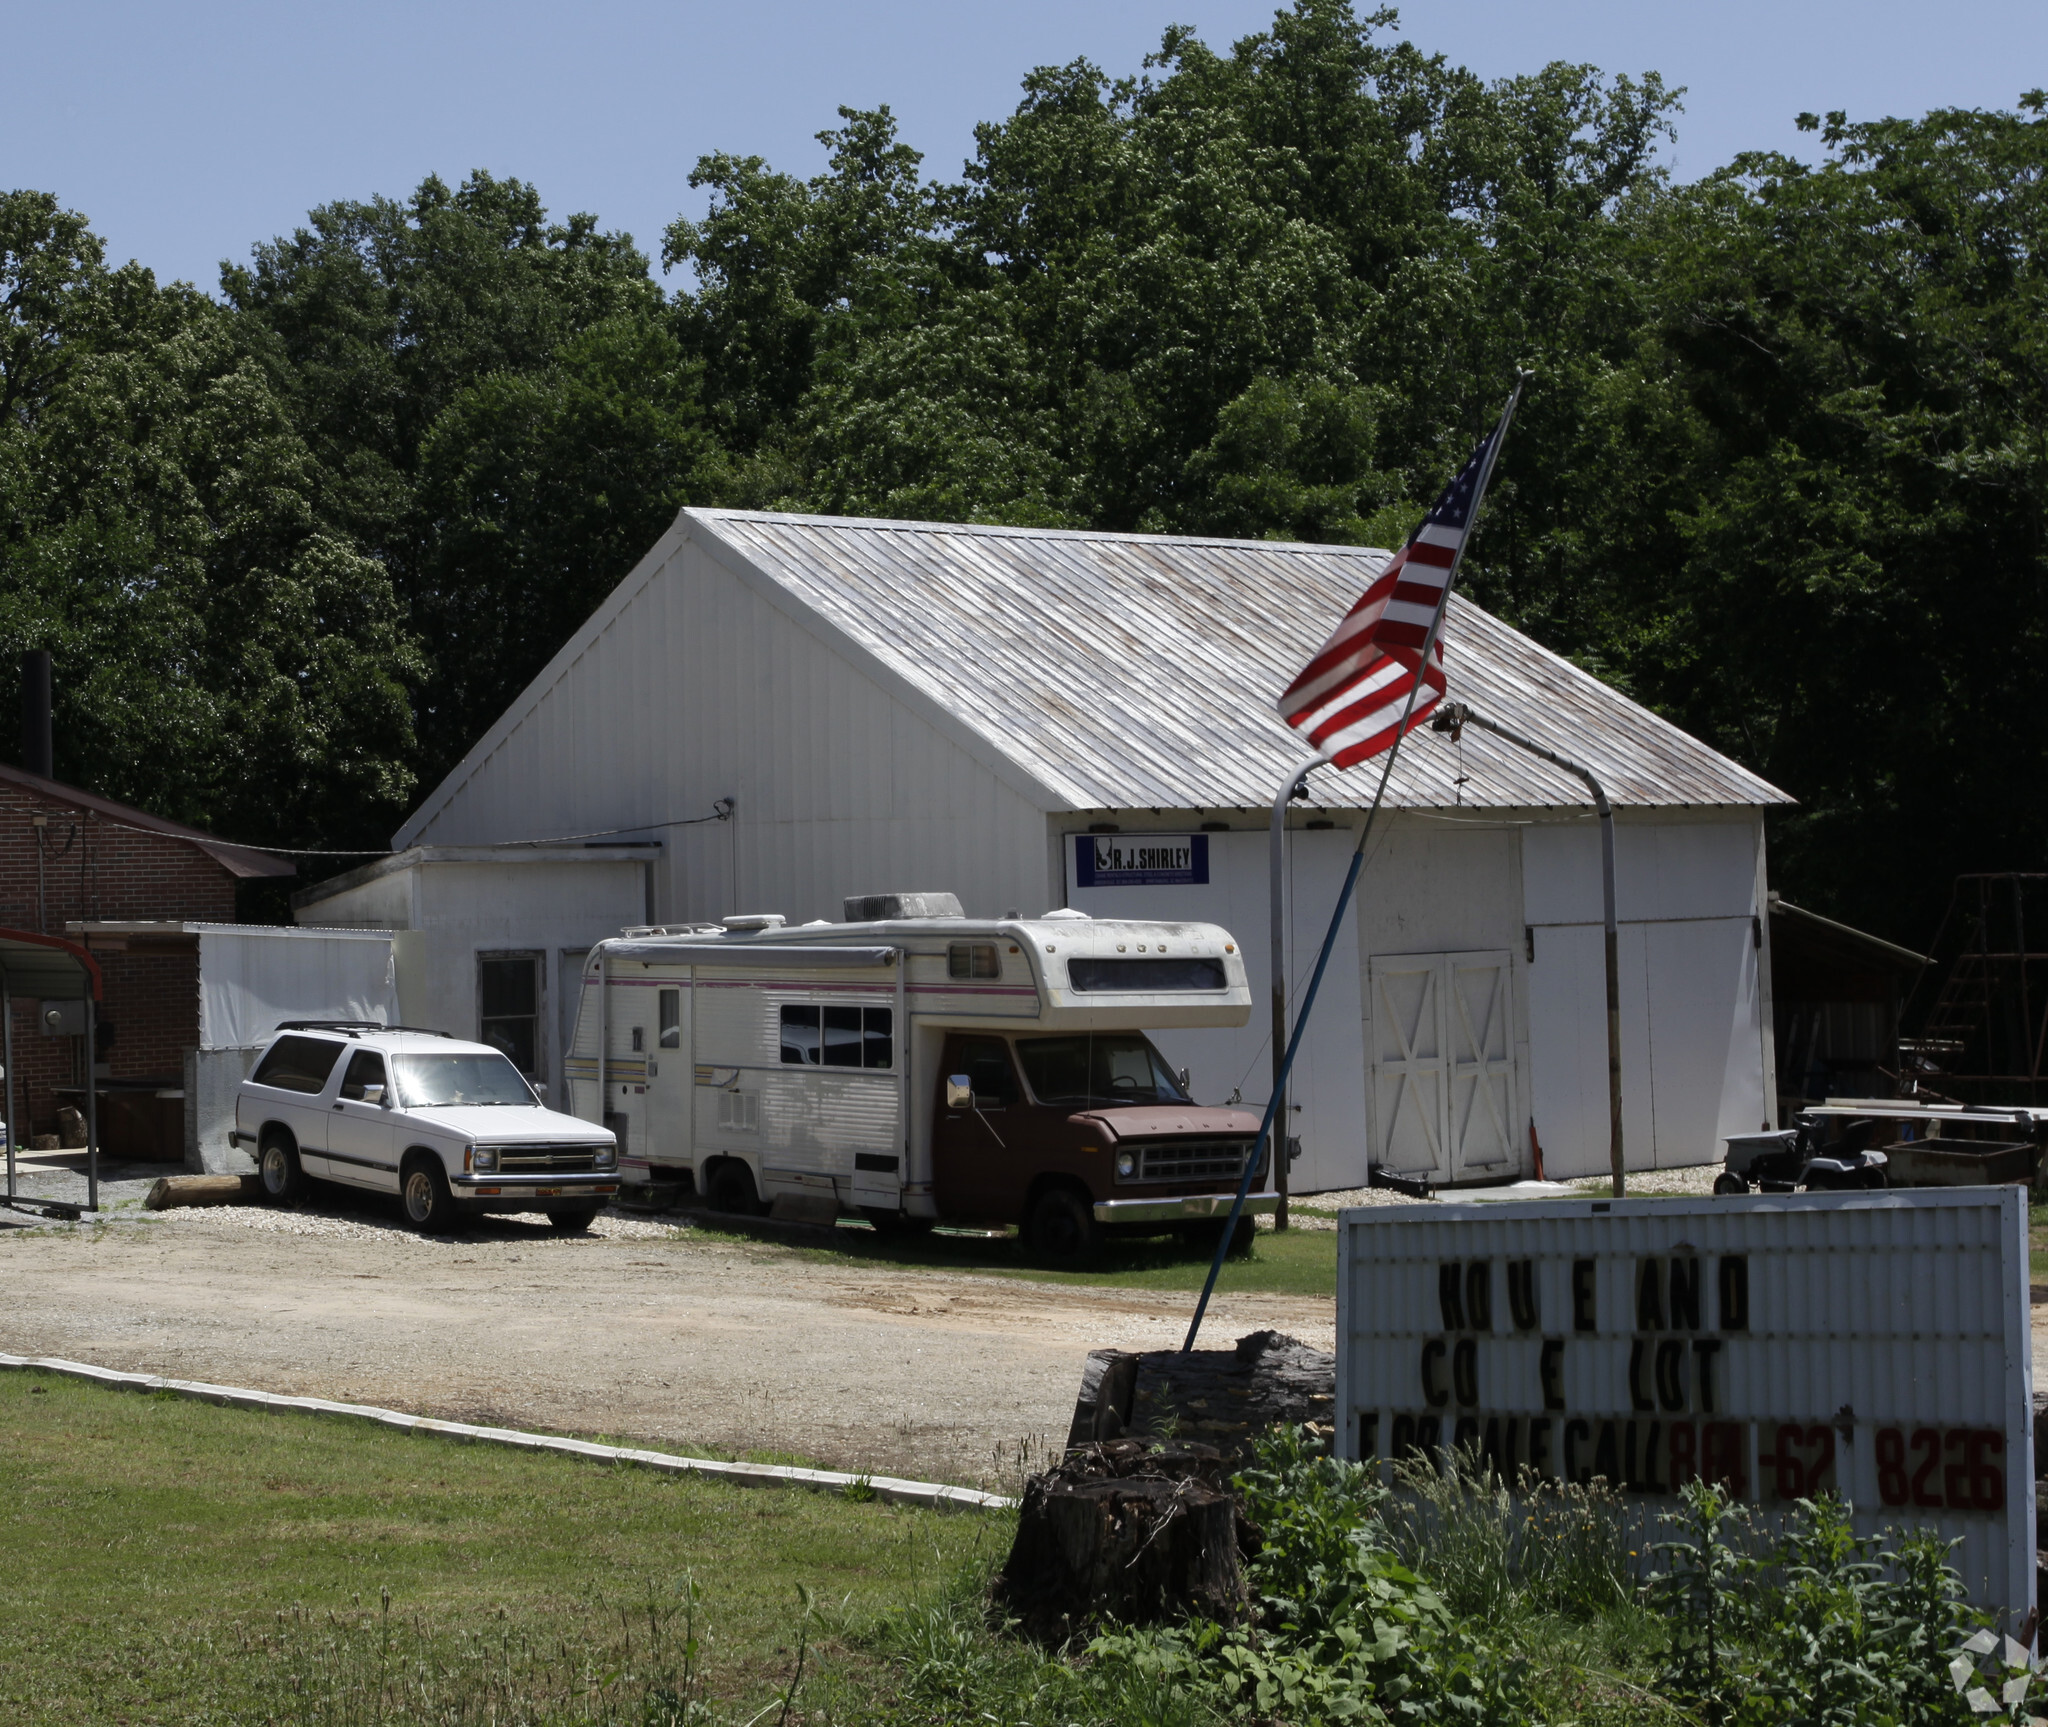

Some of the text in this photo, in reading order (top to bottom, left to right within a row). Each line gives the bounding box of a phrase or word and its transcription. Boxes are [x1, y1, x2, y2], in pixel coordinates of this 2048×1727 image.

[1638, 1256, 1749, 1331] AND
[1629, 1339, 1721, 1413] LOT
[1564, 1418, 1667, 1494] CALL
